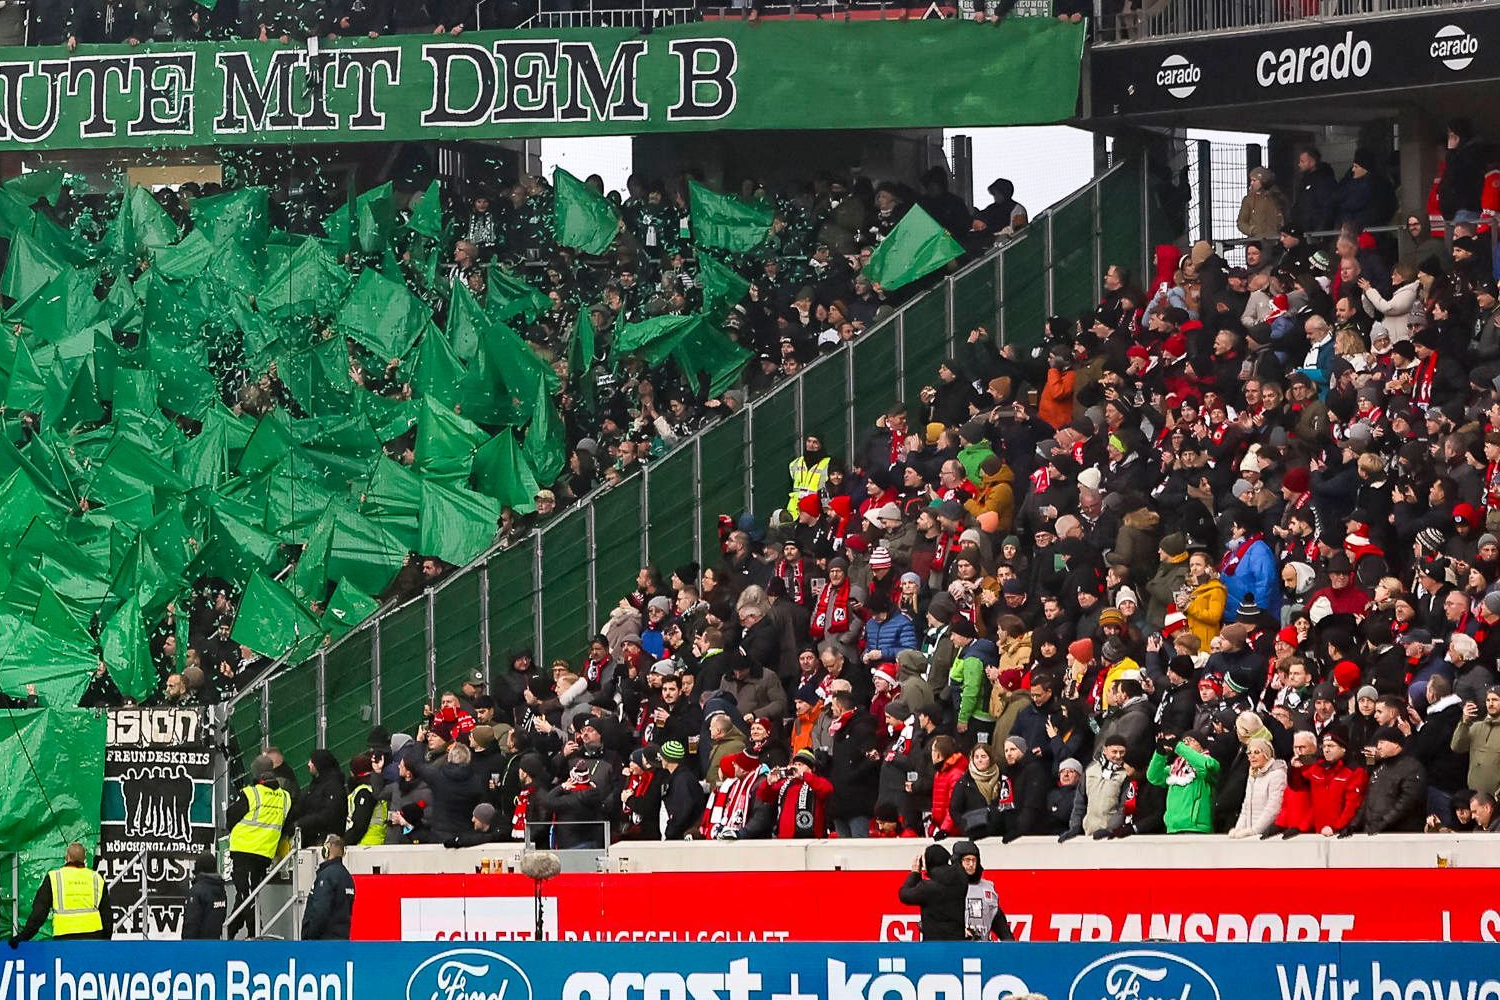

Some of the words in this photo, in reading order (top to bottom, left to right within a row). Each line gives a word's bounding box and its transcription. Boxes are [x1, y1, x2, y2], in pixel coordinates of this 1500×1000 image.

[1429, 34, 1479, 59] carado
[1255, 31, 1372, 88] carado
[212, 46, 401, 134] MIT
[419, 39, 649, 128] DEM
[666, 38, 739, 121] B
[1156, 63, 1201, 86] carado
[106, 750, 210, 765] FREUNDESKREIS
[106, 840, 205, 854] MÖNCHENGLADBACH
